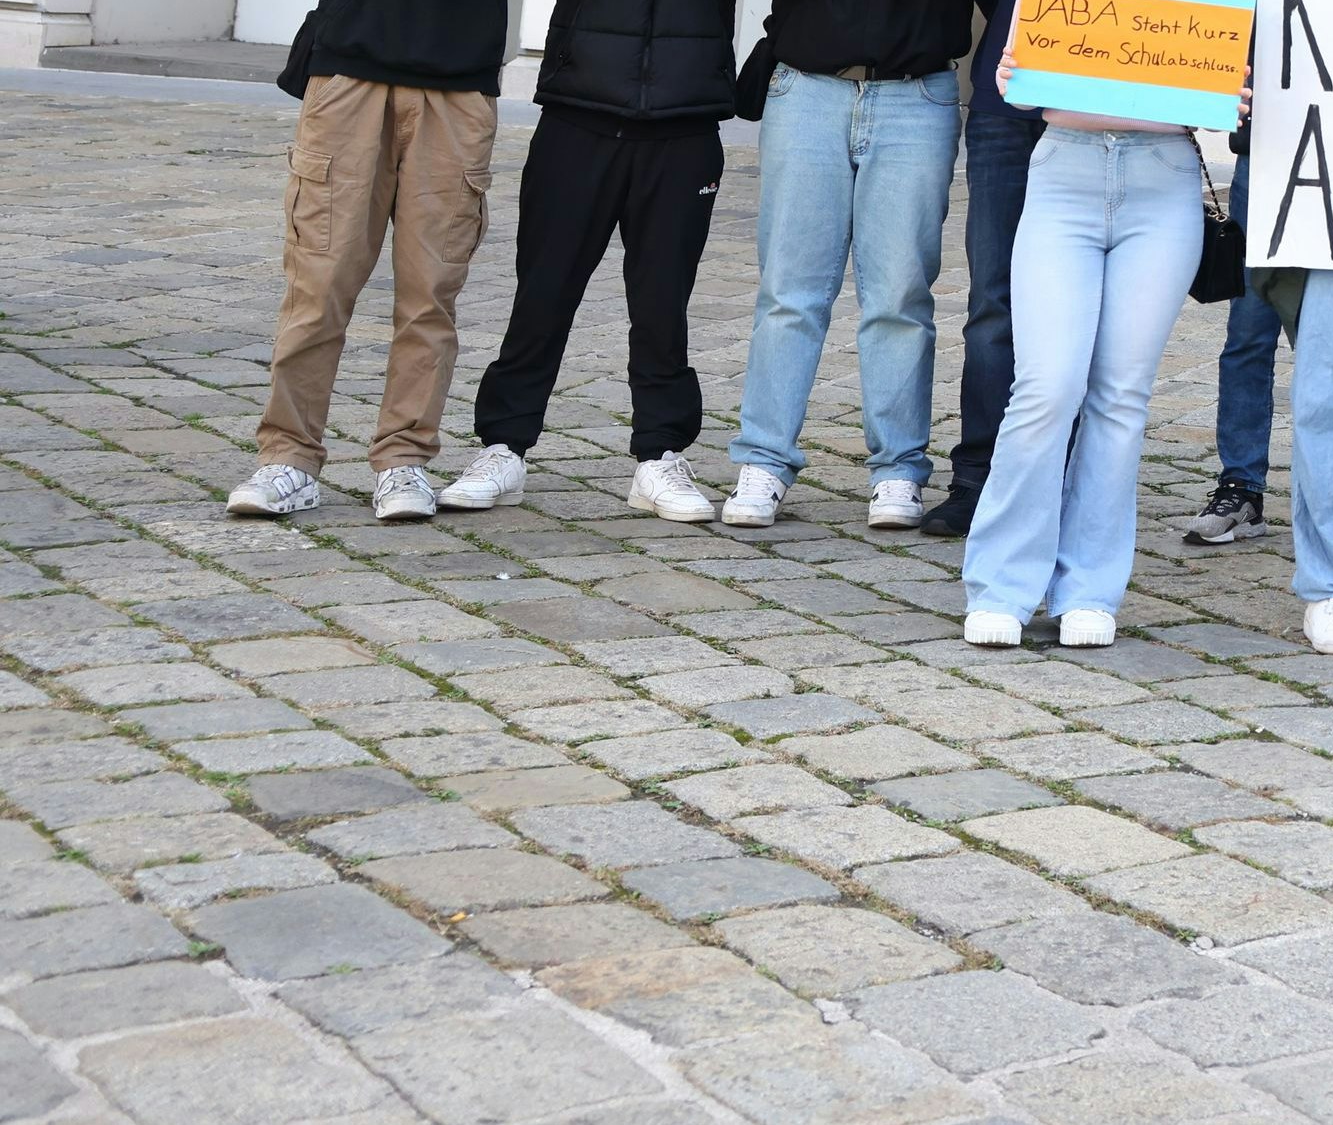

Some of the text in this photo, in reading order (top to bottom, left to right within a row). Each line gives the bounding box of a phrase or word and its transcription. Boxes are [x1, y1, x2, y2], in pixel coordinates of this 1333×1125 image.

[1132, 15, 1182, 35] Steht
[1068, 34, 1110, 60] dem
[1117, 41, 1239, 74] Schulabschluss.
